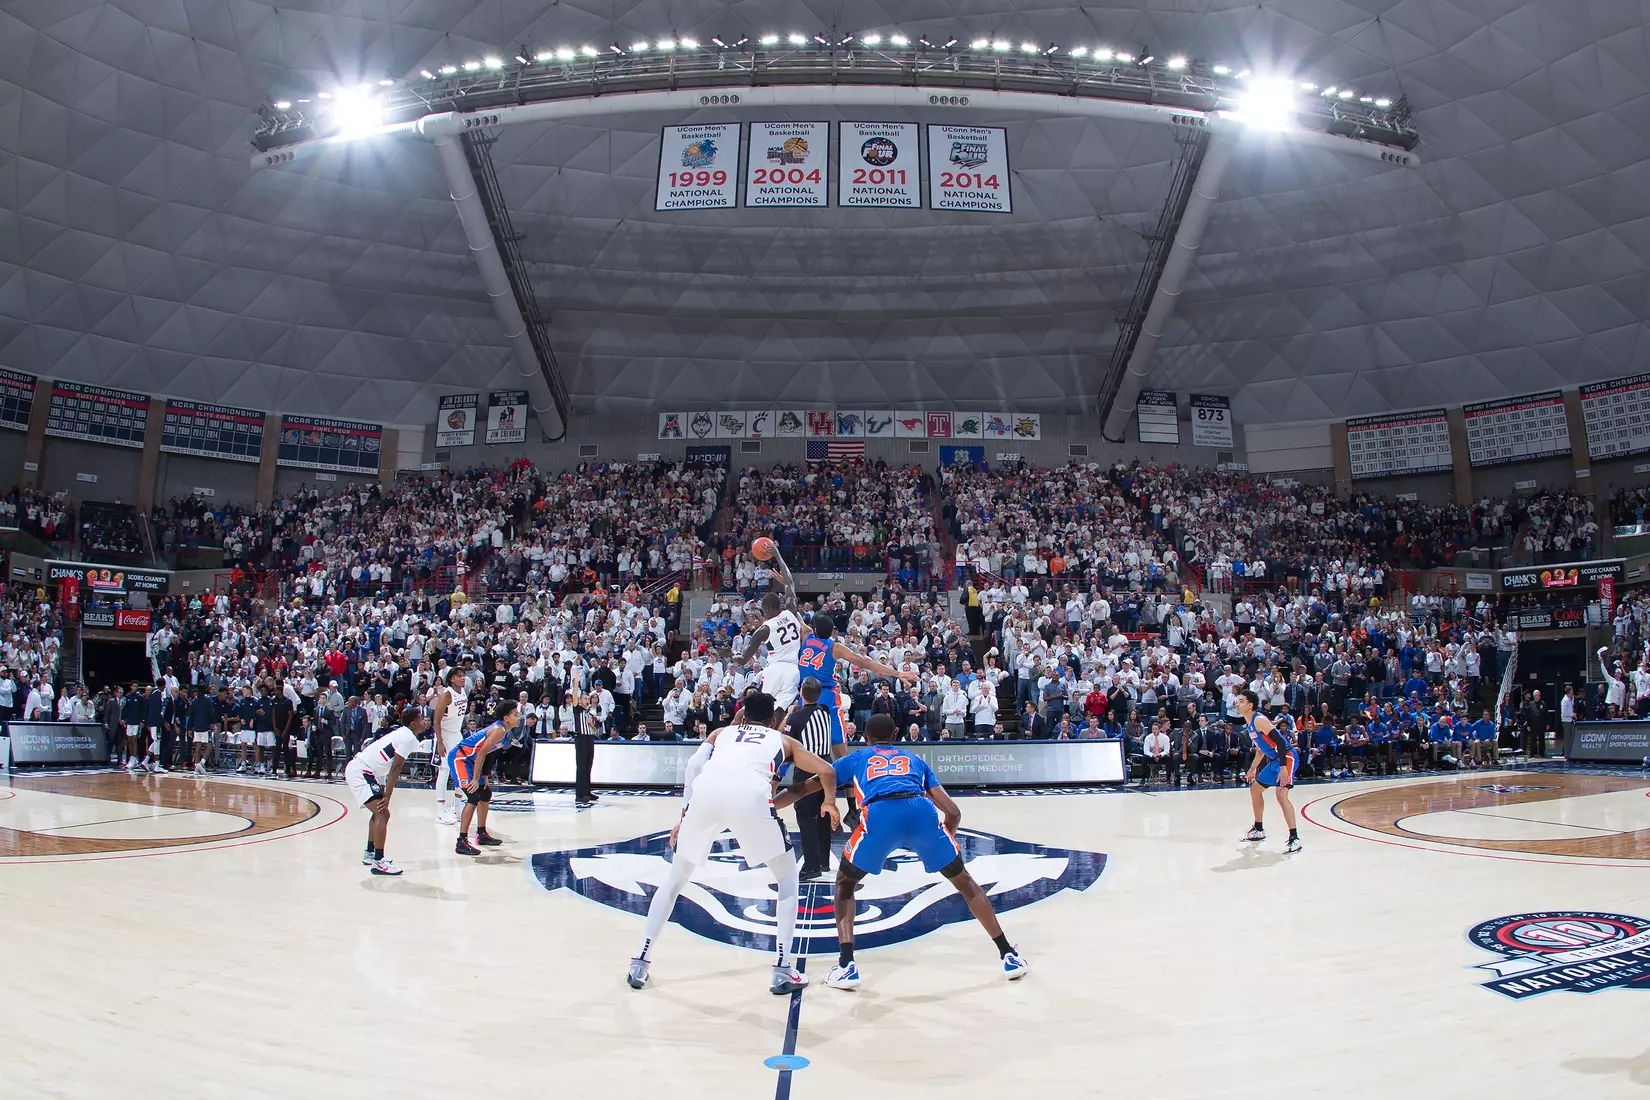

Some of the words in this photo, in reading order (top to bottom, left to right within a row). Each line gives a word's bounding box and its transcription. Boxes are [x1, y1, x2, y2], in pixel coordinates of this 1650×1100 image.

[668, 170, 727, 188] 1999
[753, 168, 822, 184] 2004
[852, 168, 906, 184] 2011
[940, 172, 1000, 190] 2014
[670, 189, 724, 198] NATIONAL
[760, 187, 814, 195] NATIONAL
[852, 187, 907, 196] NATIONAL
[944, 190, 998, 200] NATIONAL
[664, 198, 728, 208] CHAMPIONS
[848, 196, 912, 205] CHAMPIONS
[940, 200, 1002, 210] CHAMPIONS
[1198, 408, 1224, 422] 873
[720, 414, 745, 434] UCF
[50, 568, 84, 581] CHANK'S
[1504, 574, 1537, 586] CHANK'S
[84, 612, 114, 622] BEAR'S
[1520, 614, 1551, 624] BEAR'S
[1554, 608, 1582, 620] Coke
[1558, 620, 1578, 628] zero
[776, 622, 800, 646] 23
[799, 648, 826, 670] 24
[20, 734, 50, 744] UCONN
[735, 730, 766, 745] 12
[1580, 734, 1607, 742] UCONN
[937, 754, 1006, 762] ORTHOPEDICS
[866, 756, 910, 780] 23
[937, 764, 975, 772] SPORTS
[1498, 956, 1640, 994] NATIONAL
